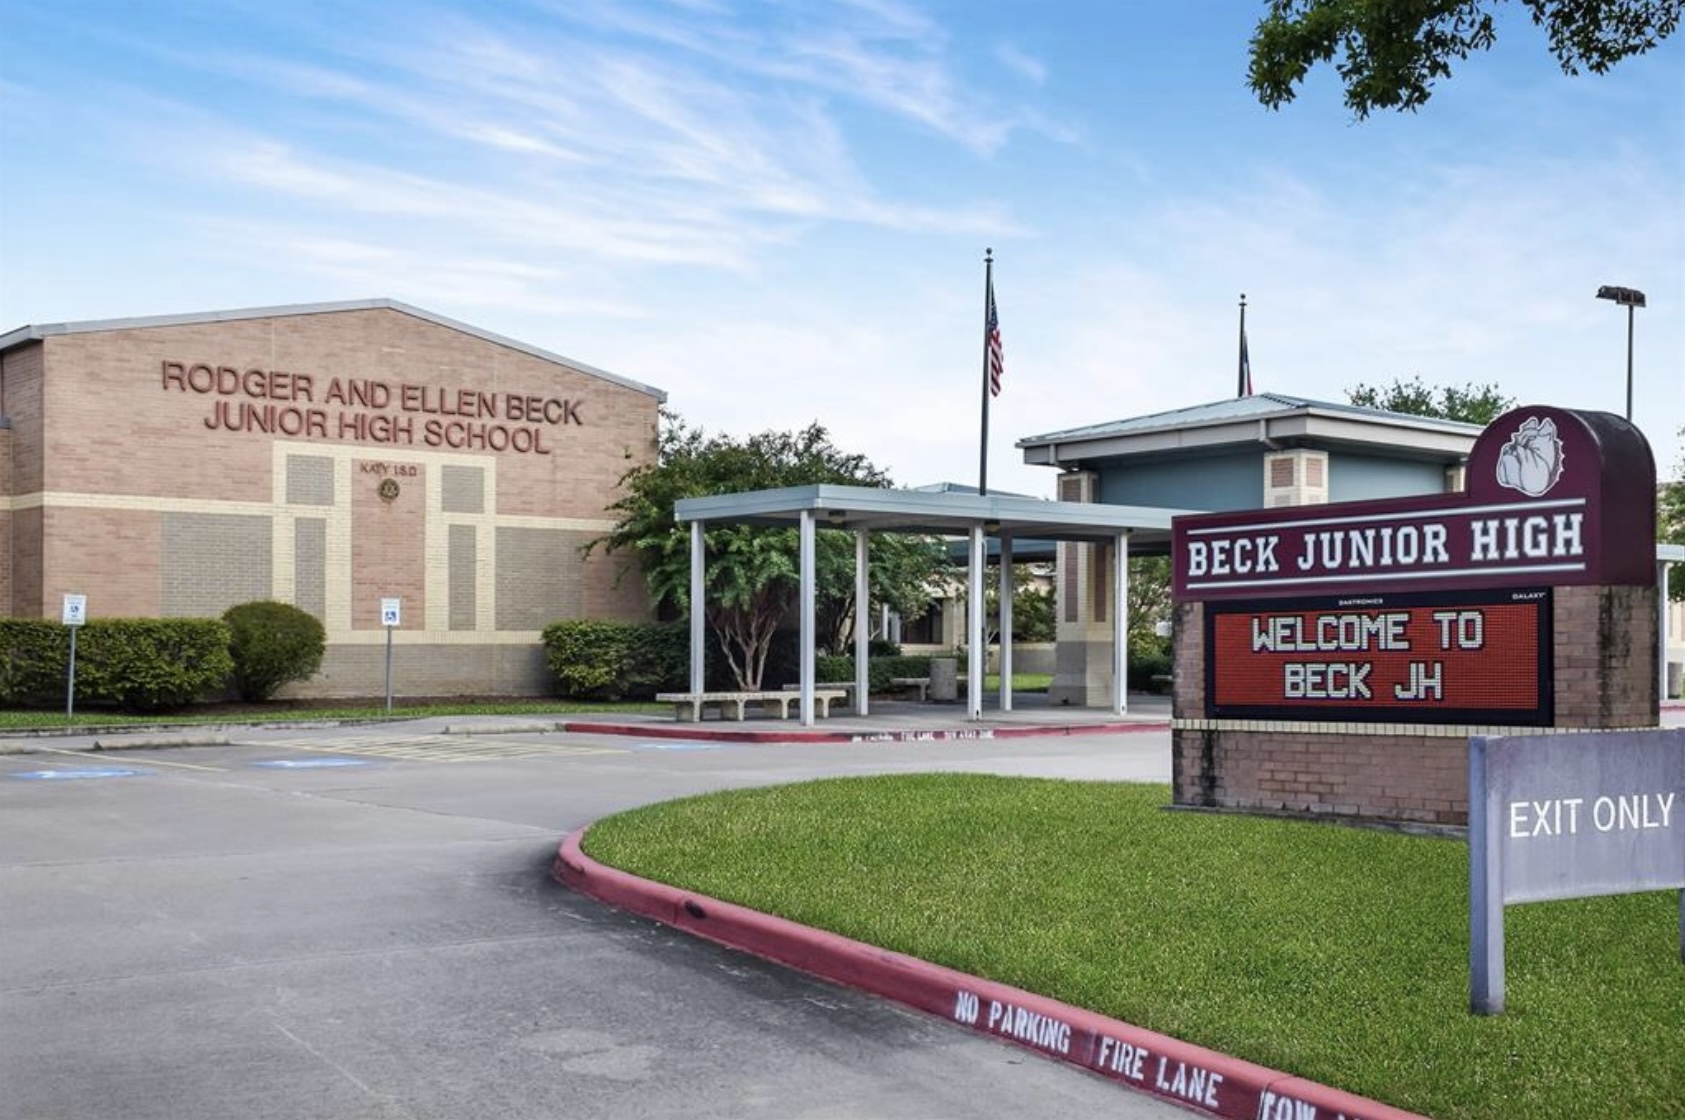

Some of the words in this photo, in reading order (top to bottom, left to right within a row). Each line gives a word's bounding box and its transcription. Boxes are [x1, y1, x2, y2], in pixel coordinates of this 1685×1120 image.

[162, 360, 314, 402] RODGER
[324, 377, 391, 409] AND
[402, 384, 498, 418] ELLEN
[506, 393, 583, 426] BECK
[204, 401, 327, 438] JUNIOR
[339, 411, 413, 444] HIGH
[424, 419, 550, 455] SCHOOL
[360, 461, 390, 475] KATY
[1188, 535, 1280, 577] BECK
[1297, 523, 1449, 570] JUNIOR
[1471, 513, 1583, 561] HIGH
[1252, 612, 1410, 651] WELCOME
[1433, 611, 1484, 649] TO
[1284, 662, 1372, 698] BECK
[1395, 662, 1442, 699] JH
[1510, 798, 1583, 838] EXIT
[1593, 792, 1675, 832] ONLY
[954, 990, 979, 1026] NO
[988, 1000, 1071, 1054] PARKING
[1099, 1036, 1148, 1081] FIRE
[1155, 1056, 1224, 1107] LANE
